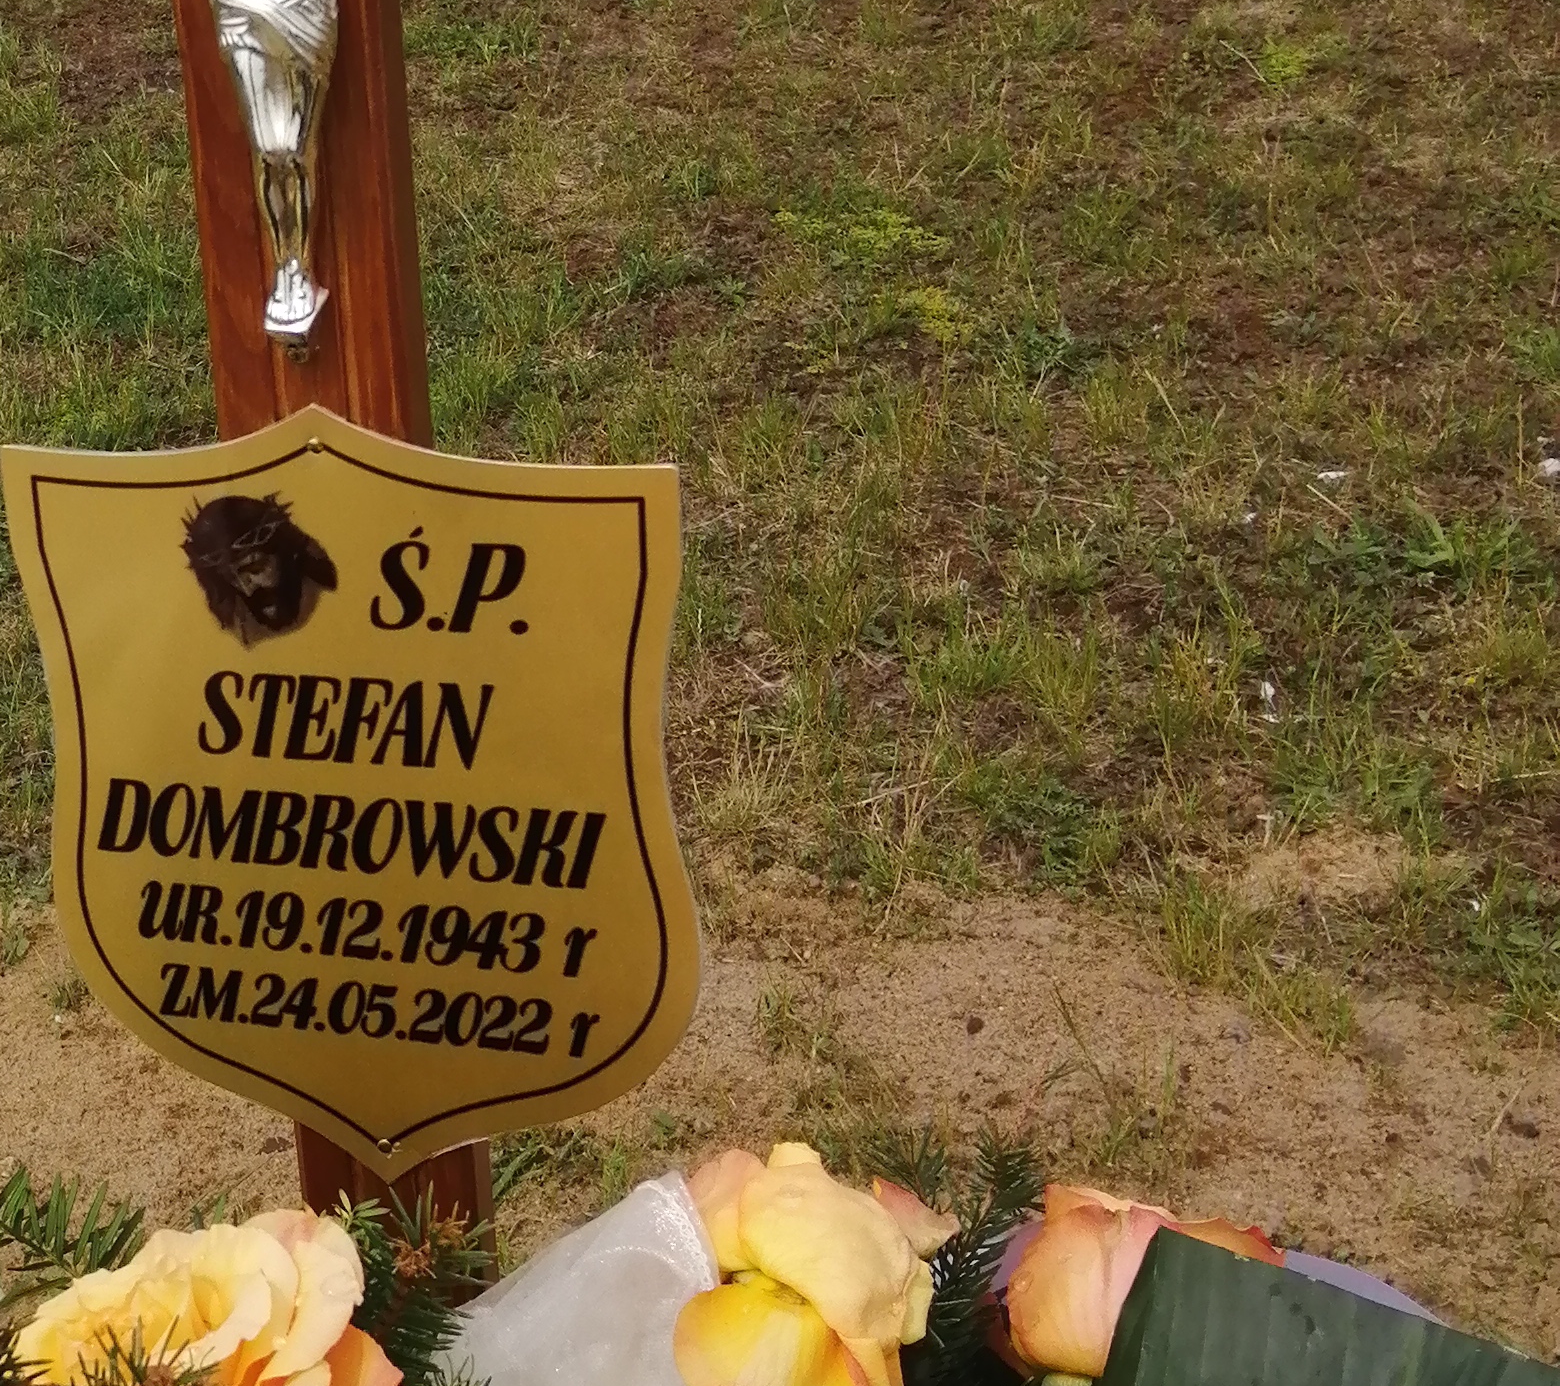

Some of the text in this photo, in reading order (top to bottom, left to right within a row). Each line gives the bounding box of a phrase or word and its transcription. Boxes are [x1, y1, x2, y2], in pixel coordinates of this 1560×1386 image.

[370, 525, 529, 636] Ś.P.
[197, 670, 495, 771] STEFAN
[97, 777, 607, 890] DOMBROWSKI
[137, 880, 598, 979] UR.19.12.1943 r
[158, 962, 601, 1059] ZM.24.05.2022 r
